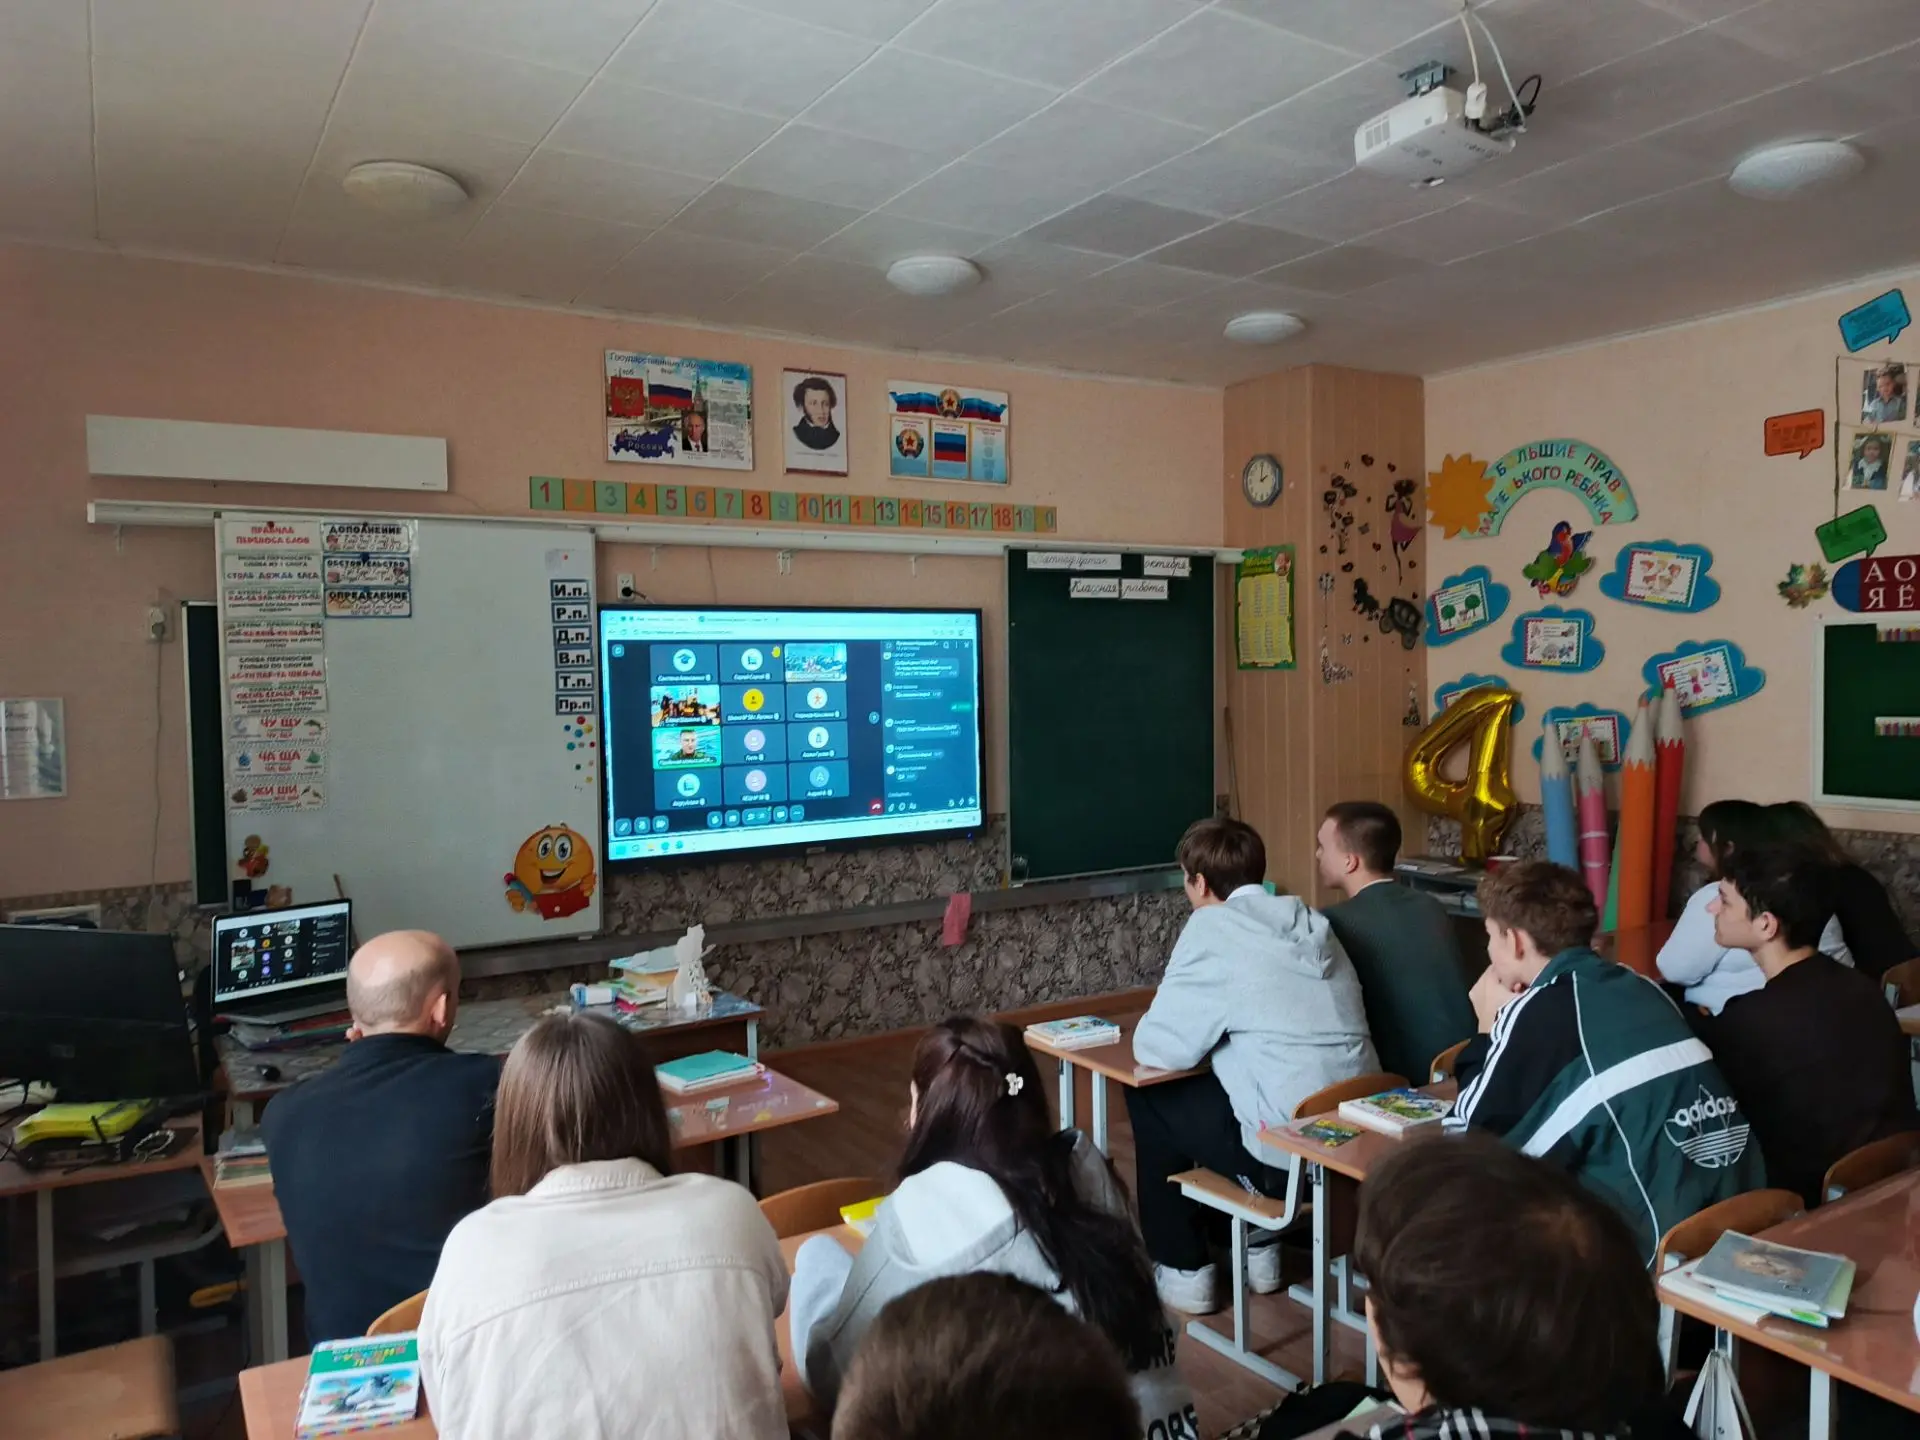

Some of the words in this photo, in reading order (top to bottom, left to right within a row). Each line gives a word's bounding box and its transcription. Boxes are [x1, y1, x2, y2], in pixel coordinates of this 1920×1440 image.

[1496, 443, 1577, 477] БОЛЬШИЕ
[1584, 452, 1627, 506] ПРАВА
[540, 481, 549, 503] 1
[605, 486, 617, 506] 3
[634, 487, 647, 509] 4
[665, 489, 678, 511] 5
[694, 491, 706, 512] 6
[723, 493, 734, 514] 7
[751, 494, 762, 516] 8
[779, 496, 789, 517] 9
[799, 497, 819, 518] 10
[824, 498, 842, 519] 11
[877, 501, 895, 521] 13
[901, 503, 918, 522] 14
[924, 505, 941, 525] 15
[947, 506, 965, 526] 16
[971, 507, 988, 527] 17
[994, 508, 1011, 528] 18
[1015, 509, 1031, 529] 19
[1478, 465, 1561, 536] МАЛЕНЬКОГО
[329, 526, 402, 535] ДОПОЛНЕНИЕ
[1863, 561, 1885, 583] А
[1894, 559, 1917, 581] О
[554, 584, 588, 597] И.п.
[1071, 580, 1117, 596] Классная
[1123, 580, 1166, 597] работа
[329, 591, 407, 600] ОПРЕДЕЛЕНИЕ
[1866, 587, 1886, 610] Я
[1897, 584, 1915, 608] Ё
[556, 607, 588, 619] Р.п.
[557, 629, 590, 645] Д.п.
[558, 652, 590, 664] В.п.
[560, 675, 591, 687] Т.п.
[260, 718, 277, 728] ЧУ
[258, 751, 276, 761] ЧА
[252, 786, 274, 795] ЖИ
[277, 785, 298, 794] ШИ
